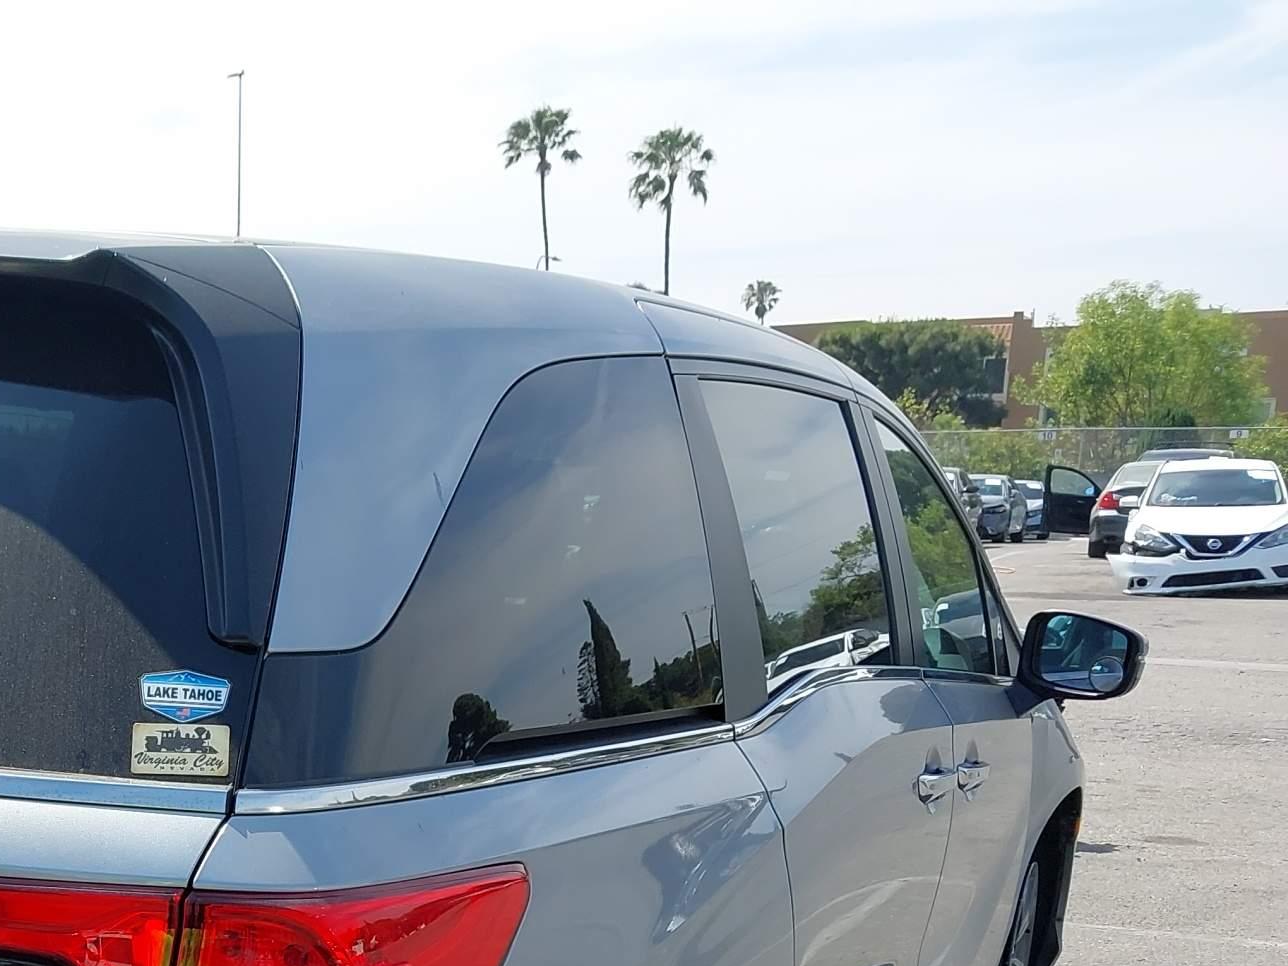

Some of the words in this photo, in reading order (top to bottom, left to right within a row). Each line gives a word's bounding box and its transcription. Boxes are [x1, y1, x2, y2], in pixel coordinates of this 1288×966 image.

[146, 685, 179, 699] LAKE
[182, 688, 223, 702] TAHOE
[134, 751, 189, 769] Virginia
[193, 754, 225, 769] City
